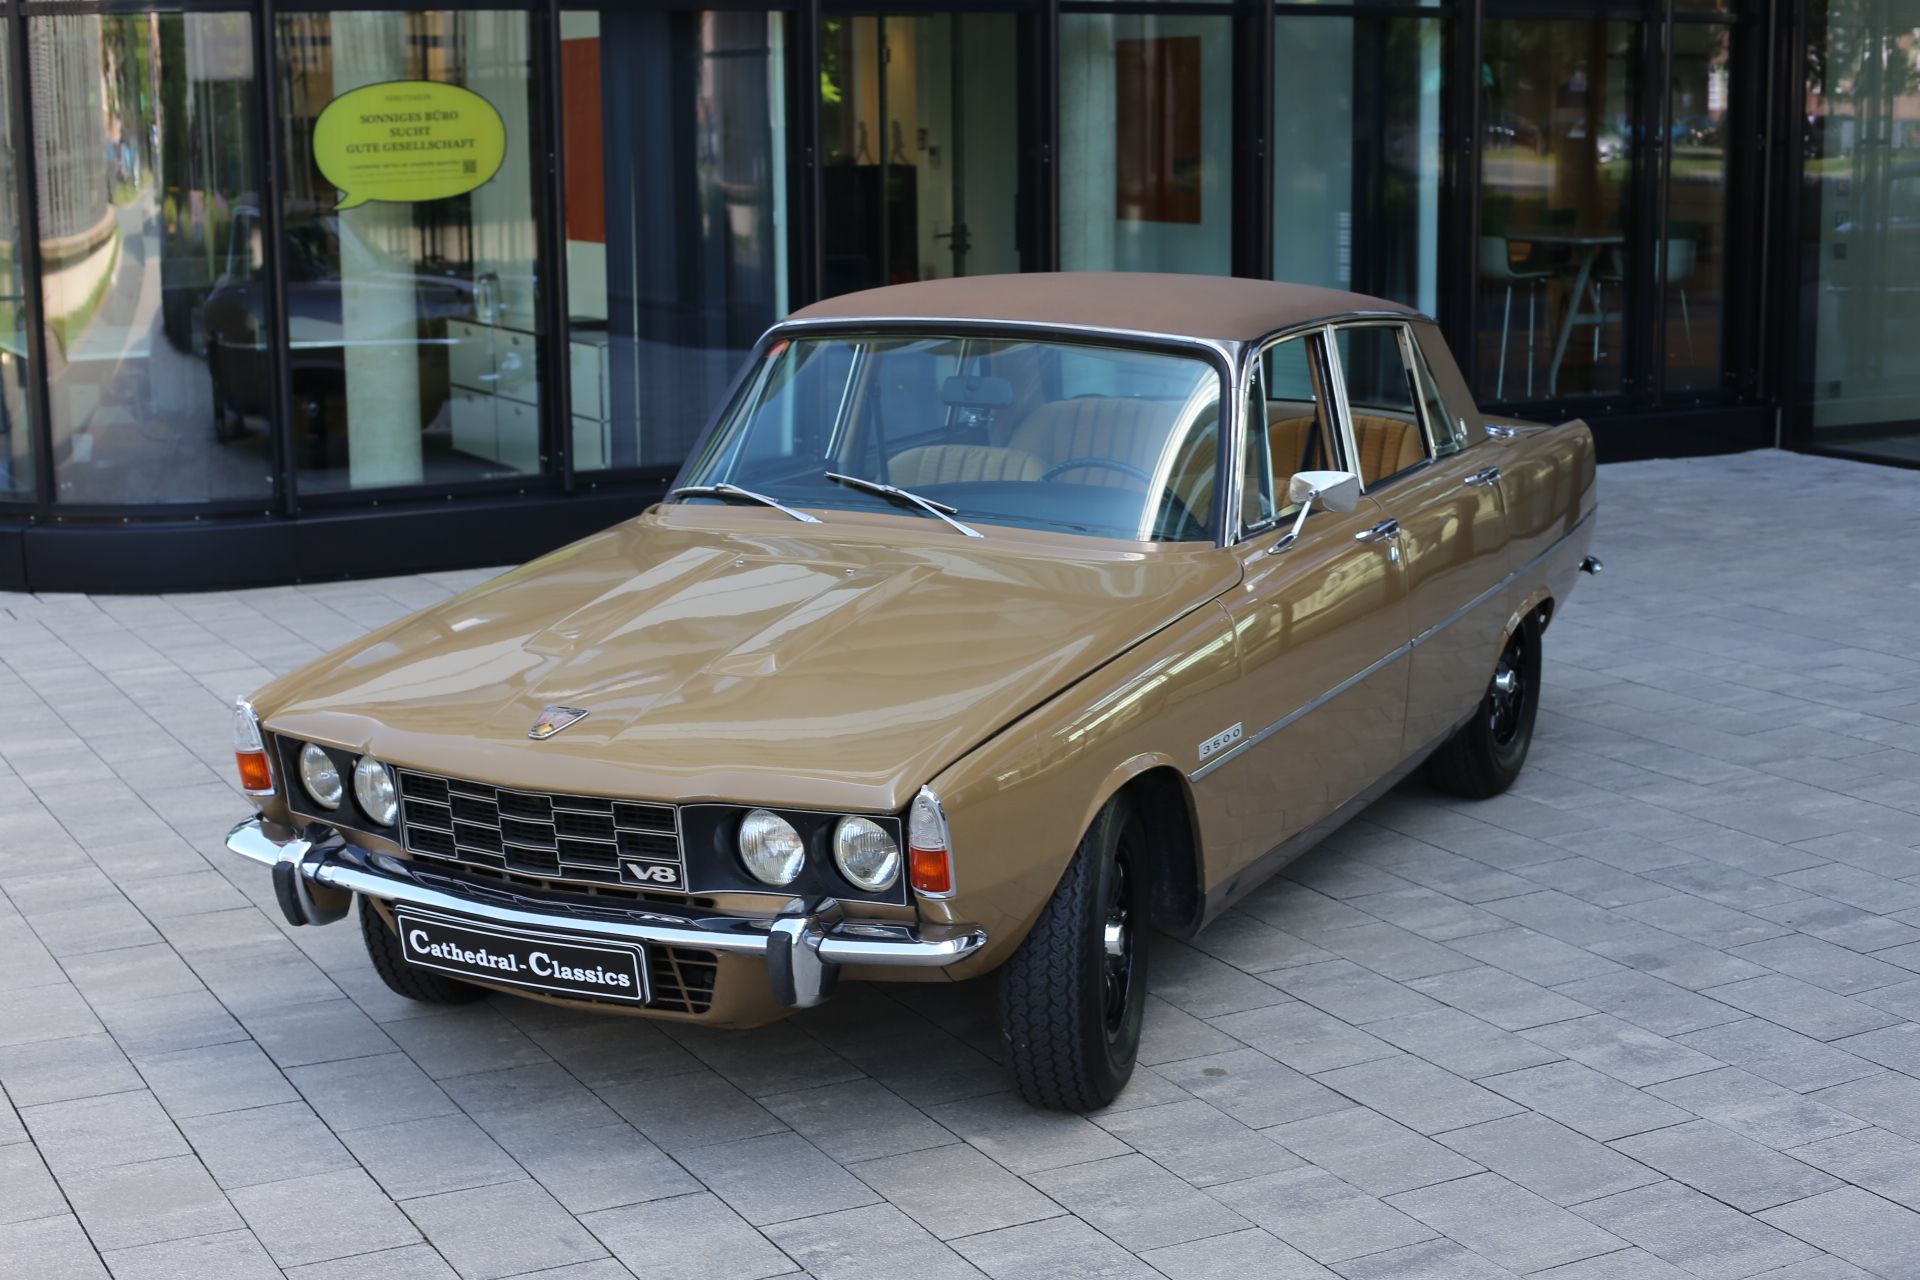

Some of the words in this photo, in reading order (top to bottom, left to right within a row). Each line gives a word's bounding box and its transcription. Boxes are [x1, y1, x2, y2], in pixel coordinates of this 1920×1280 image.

[360, 112, 422, 123] SONNIGES
[425, 109, 459, 121] BÜRO
[390, 126, 431, 137] SUCHT
[346, 143, 380, 154] GUTE
[382, 138, 476, 152] GESELLSCHAFT
[1203, 728, 1240, 755] 3500
[626, 863, 677, 883] V8
